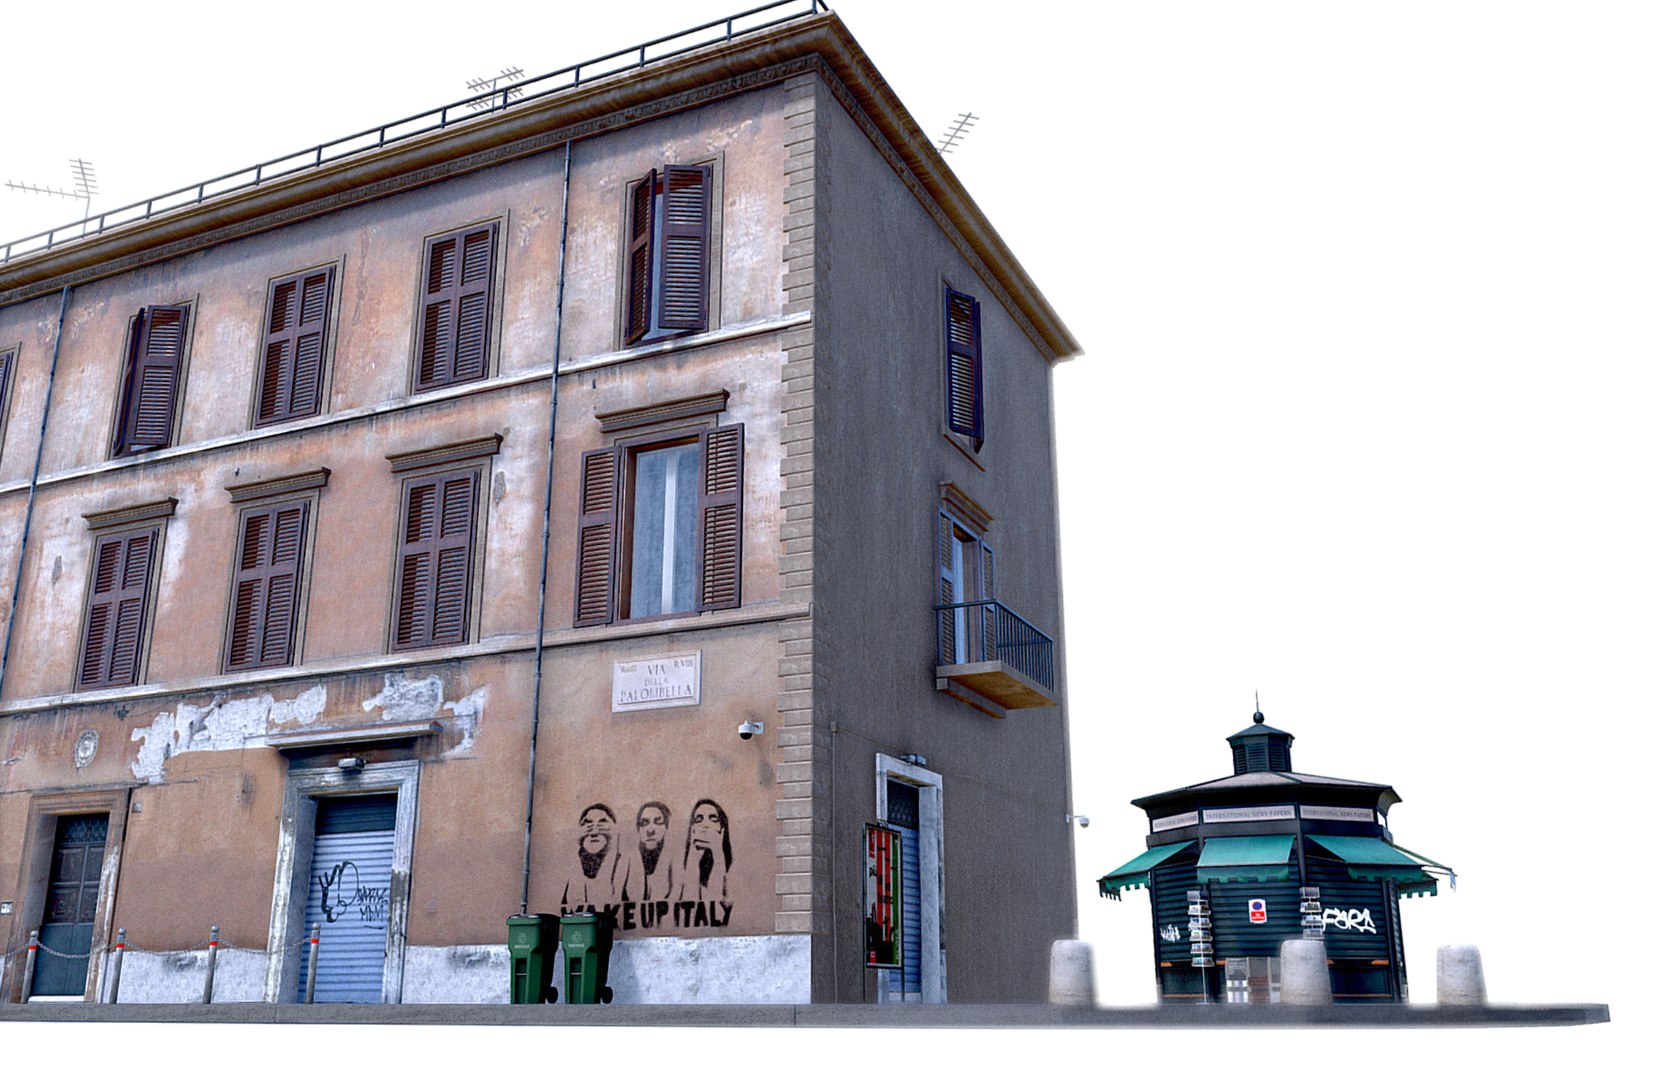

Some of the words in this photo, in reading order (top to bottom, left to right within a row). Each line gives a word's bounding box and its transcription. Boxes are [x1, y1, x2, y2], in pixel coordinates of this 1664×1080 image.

[648, 664, 666, 675] VIA
[620, 684, 692, 703] PALOMBELLA
[640, 901, 669, 929] UP
[674, 900, 733, 928] ITALY
